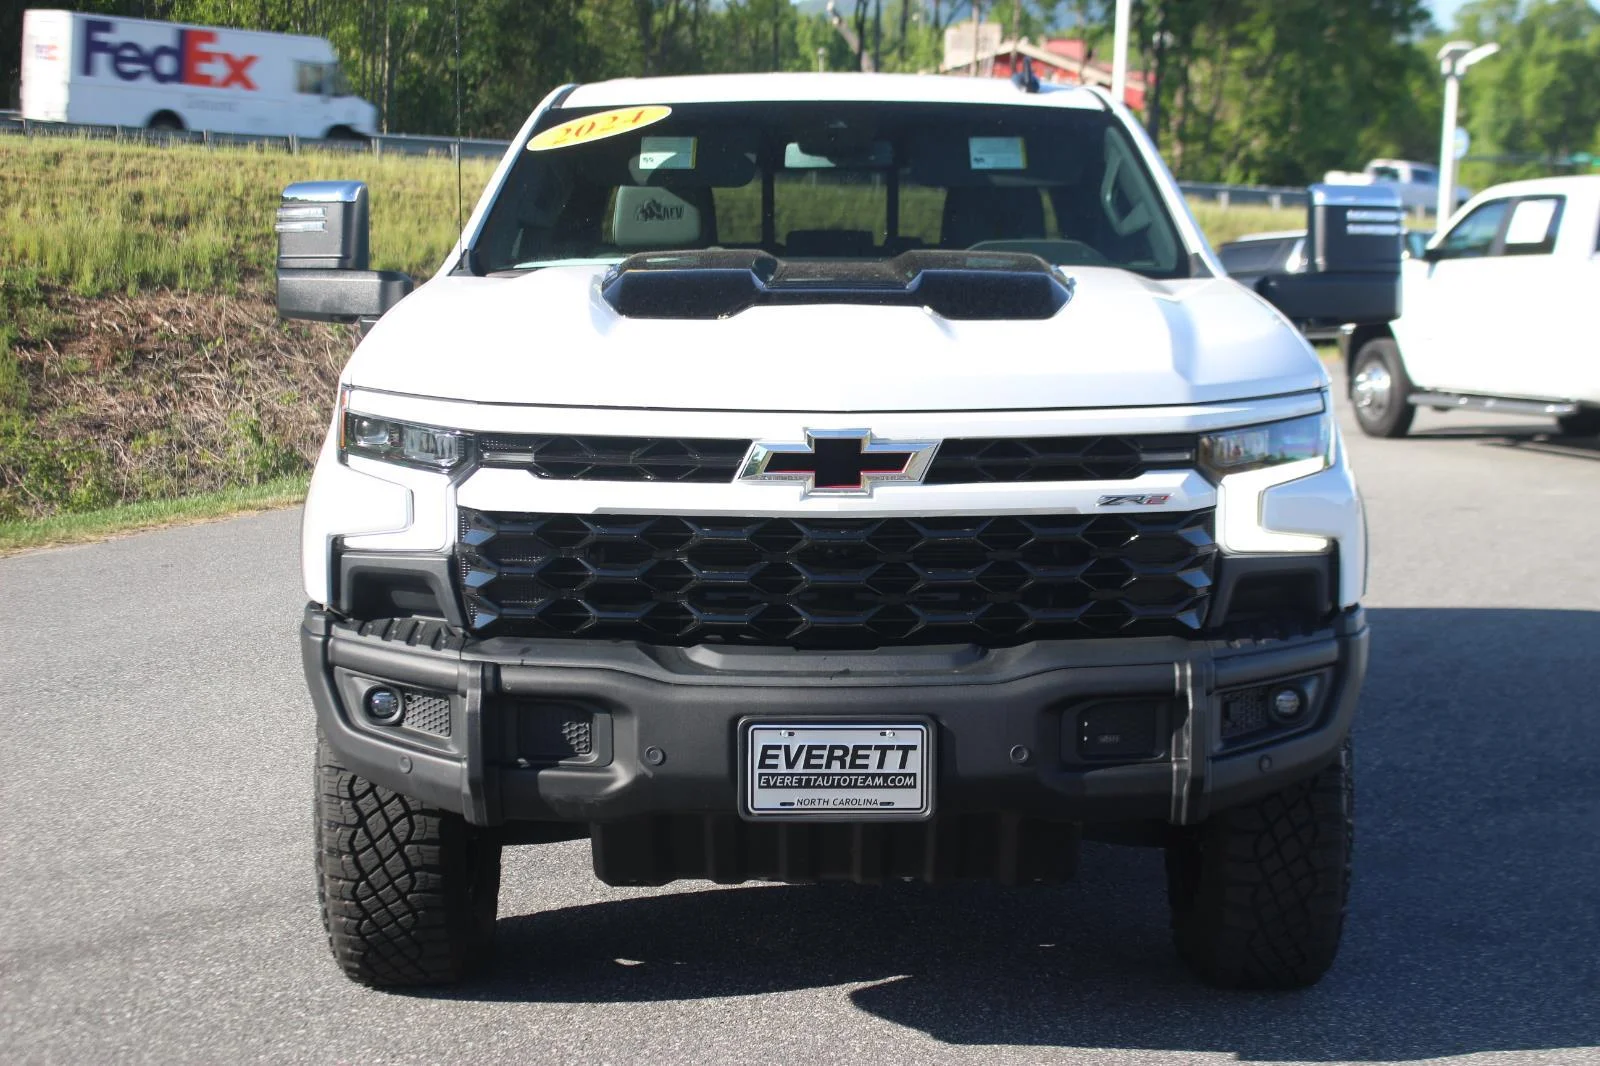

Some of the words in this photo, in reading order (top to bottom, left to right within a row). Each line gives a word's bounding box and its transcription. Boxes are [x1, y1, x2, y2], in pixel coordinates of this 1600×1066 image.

[79, 19, 260, 91] FedEx
[1096, 492, 1174, 506] ZR2
[757, 744, 918, 770] EVERETT
[759, 775, 915, 787] EVERETTAUTOTEAM.COM
[796, 798, 830, 807] NORTH
[832, 798, 879, 807] CAROLINA
